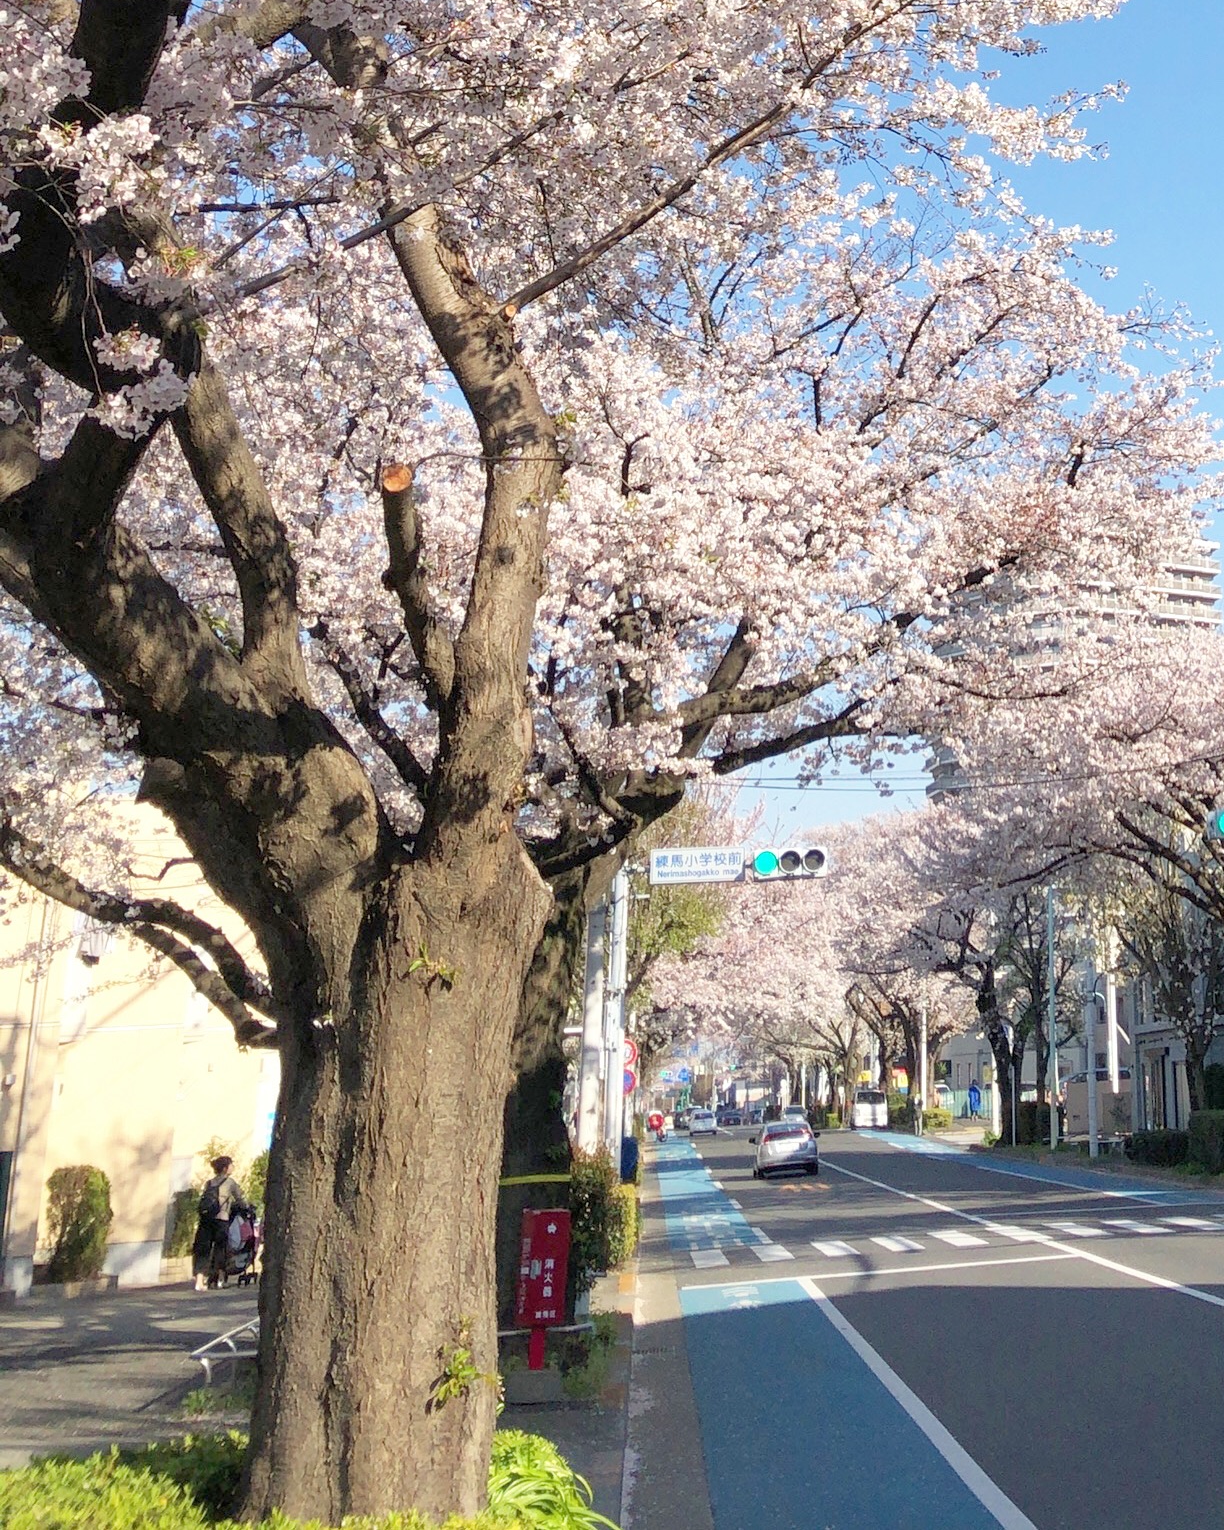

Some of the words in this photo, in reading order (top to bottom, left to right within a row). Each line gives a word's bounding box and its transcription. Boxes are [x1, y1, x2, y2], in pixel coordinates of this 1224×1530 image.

[656, 852, 741, 868] 練馬小学校前
[657, 868, 720, 879] Nerimashogakko
[543, 1258, 554, 1298] 消火器
